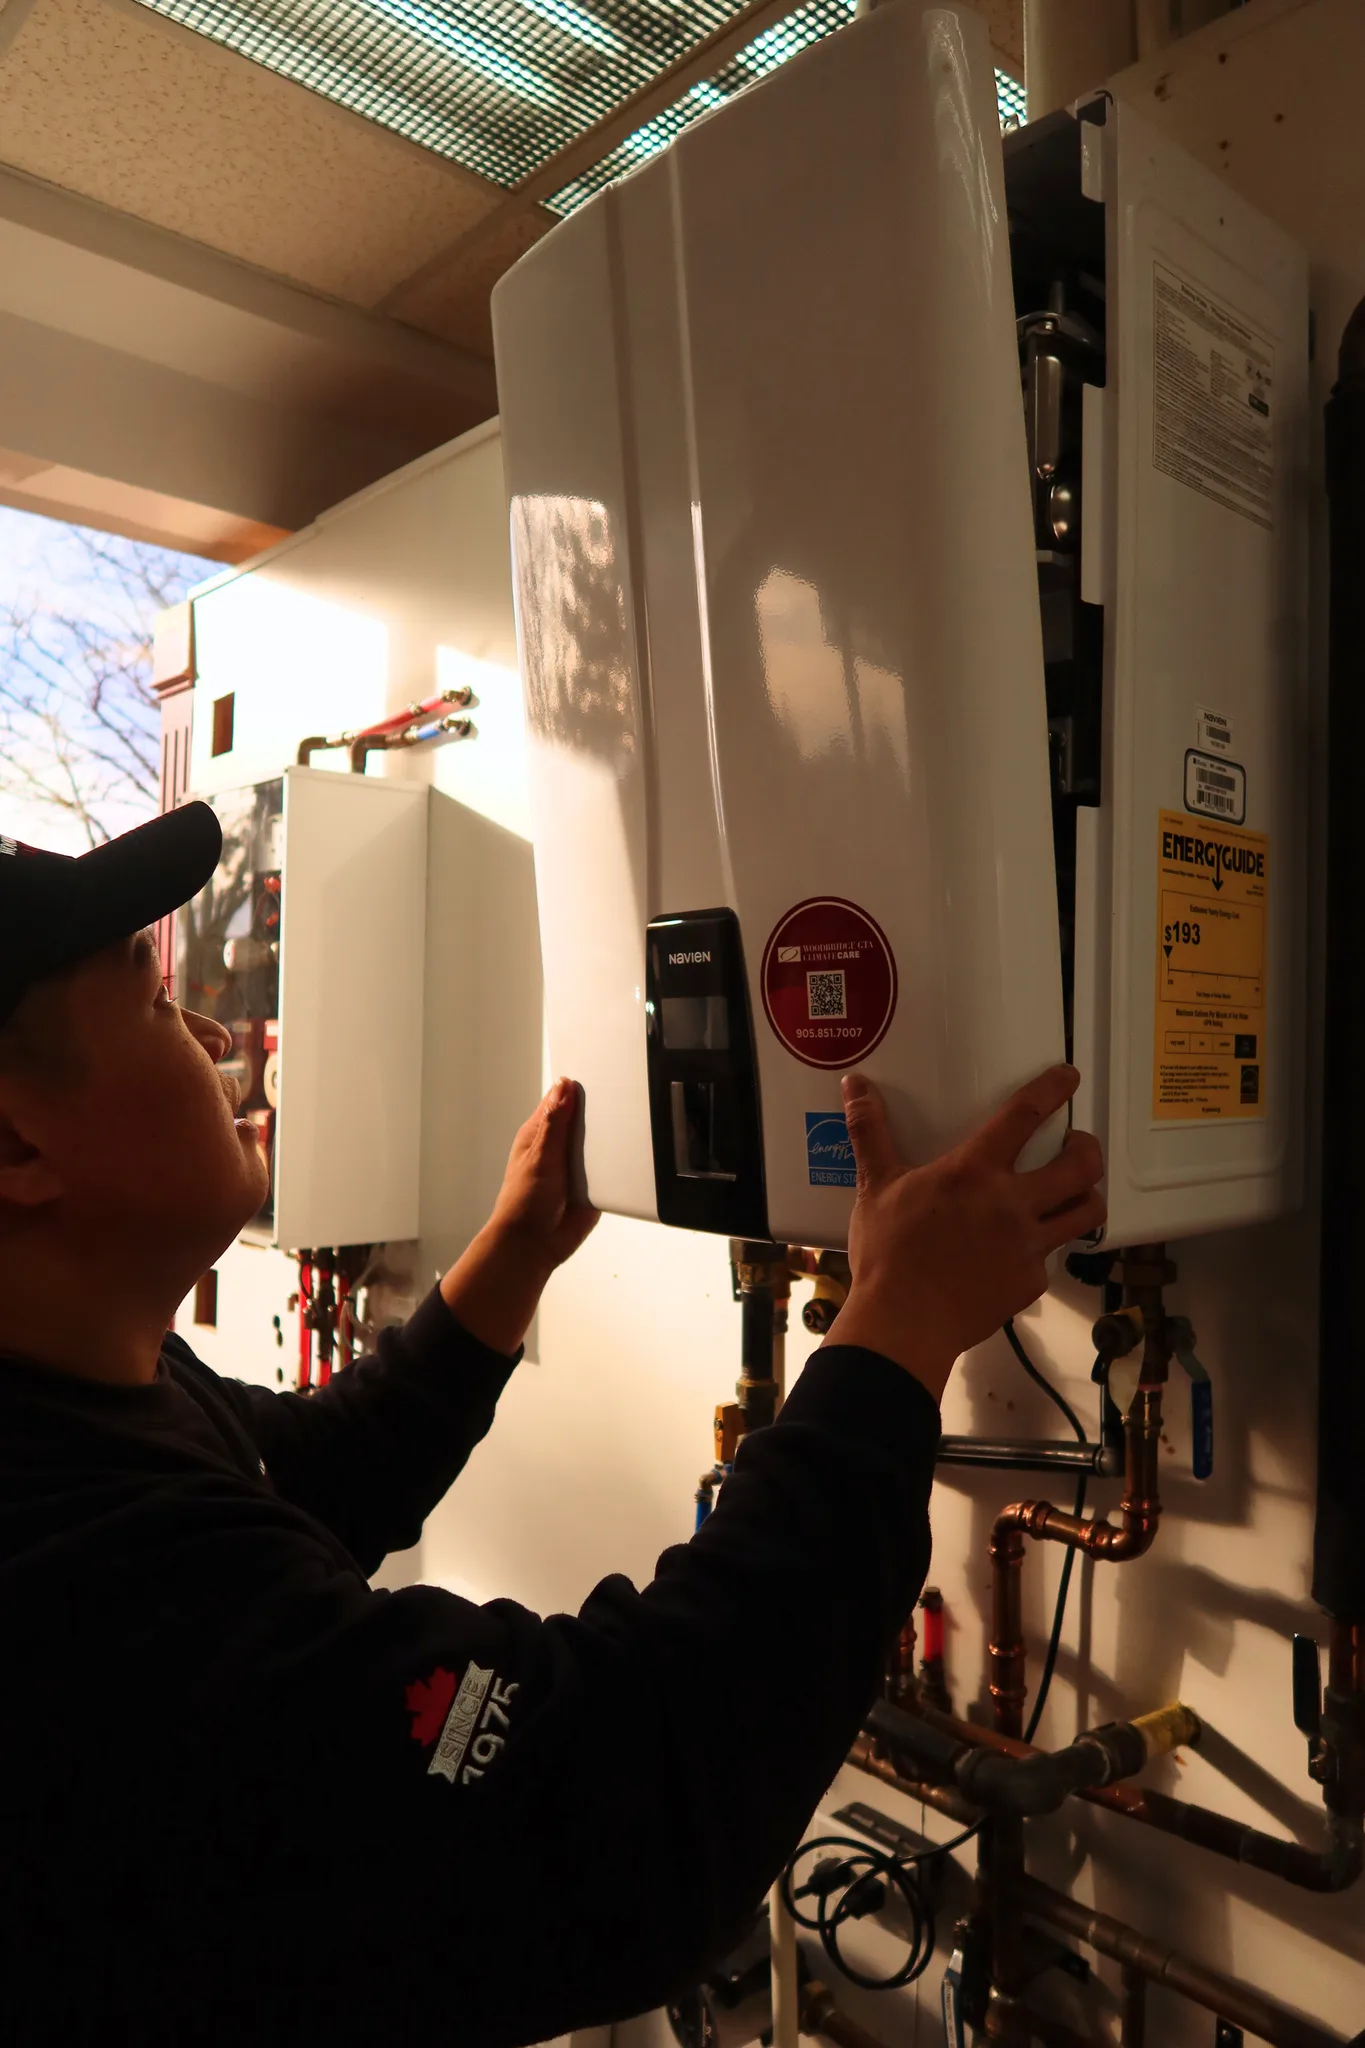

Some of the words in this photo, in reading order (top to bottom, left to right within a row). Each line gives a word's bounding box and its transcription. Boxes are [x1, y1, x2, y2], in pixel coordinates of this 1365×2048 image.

[1164, 920, 1201, 945] $193
[802, 941, 857, 953] WOODBRIDGE
[795, 1027, 863, 1039] 905.851.7007
[810, 1142, 846, 1160] energy
[810, 1171, 842, 1184] ENERGY
[440, 1677, 487, 1763] SINCE
[462, 1676, 521, 1786] 1975
